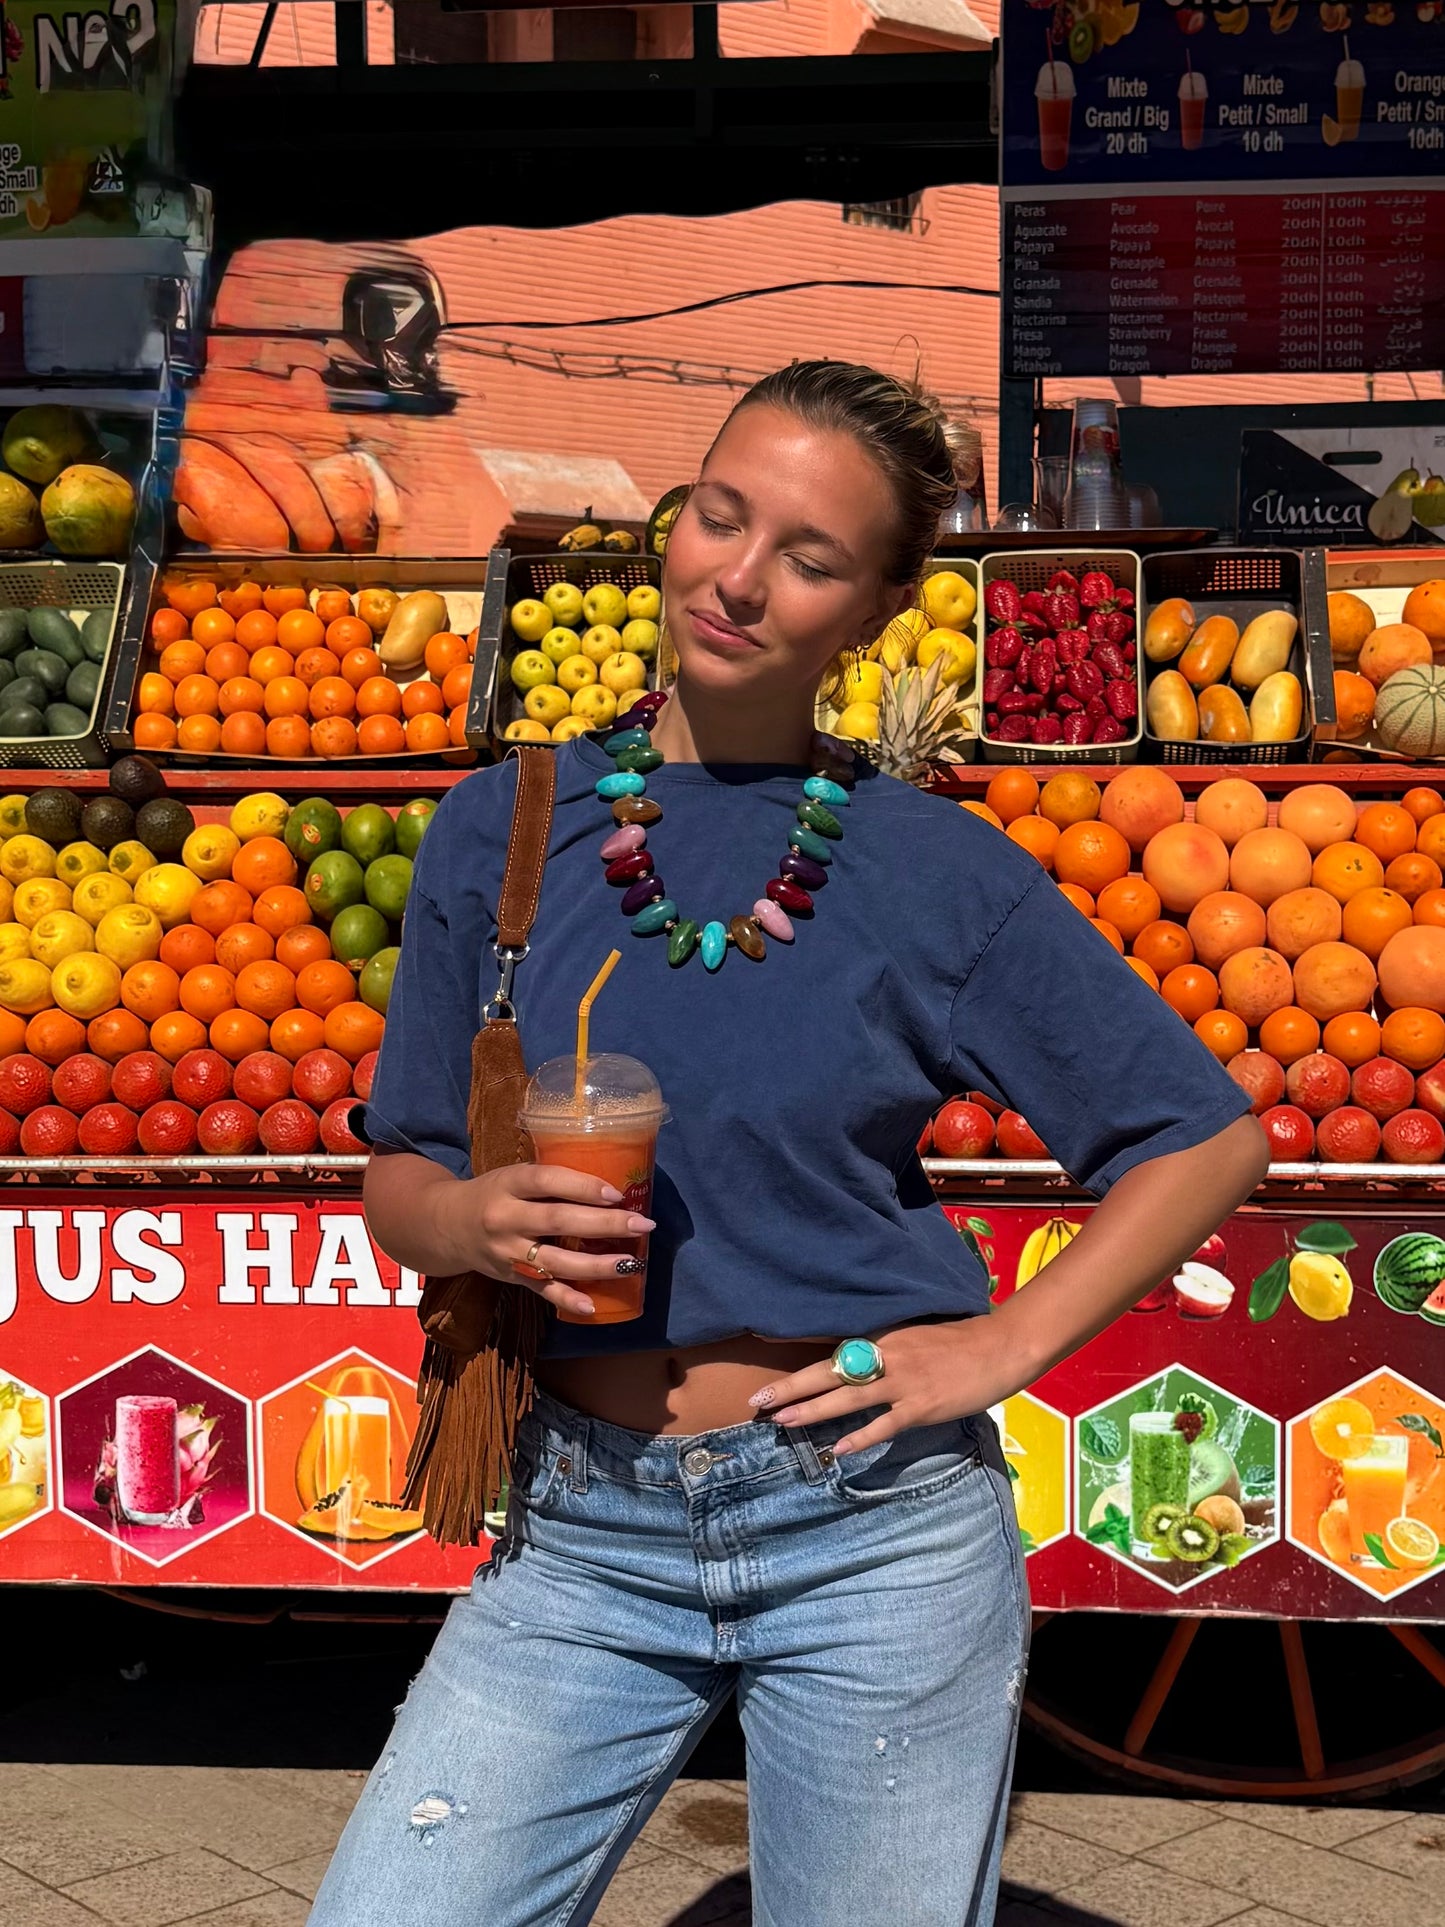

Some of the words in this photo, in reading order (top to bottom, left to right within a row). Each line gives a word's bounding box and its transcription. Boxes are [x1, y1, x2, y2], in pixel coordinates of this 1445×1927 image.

[1107, 77, 1148, 98] Mixte
[1243, 74, 1285, 95] Mixte
[1085, 107, 1132, 128] Grand
[1133, 106, 1141, 127] /
[1143, 106, 1171, 131] Big
[1218, 104, 1254, 126] Petit
[1256, 103, 1264, 125] /
[1265, 103, 1308, 125] Small
[1377, 101, 1413, 123] Petit
[1414, 99, 1422, 123] /
[1106, 133, 1125, 154] 20
[1128, 132, 1148, 154] dh
[1243, 131, 1261, 153] 10
[1264, 130, 1284, 152] dh
[1408, 127, 1445, 150] 10dh
[1014, 204, 1046, 217] Peras
[1111, 202, 1137, 216] Pear
[1282, 197, 1320, 210] 20dh
[1328, 196, 1367, 209] 10dh
[1015, 224, 1068, 240] Aguacate
[1111, 221, 1160, 235] Avocado
[1195, 219, 1234, 232] Avocat
[1281, 216, 1320, 230] 20dh
[1328, 215, 1366, 228] 10dh
[1014, 240, 1055, 255] Papaya
[1110, 239, 1152, 254] Papaya
[1281, 236, 1320, 248] 20dh
[1327, 235, 1366, 247] 10dh
[1110, 256, 1166, 272] Pineapple
[1194, 255, 1237, 268] Ananas
[1280, 254, 1319, 267] 20dh
[1327, 253, 1365, 266] 10dh
[1013, 277, 1061, 290] Granada
[1110, 277, 1159, 290] Grenade
[1193, 274, 1242, 288] Grenade
[1109, 293, 1179, 307] Watermelon
[1280, 291, 1318, 304] 20dh
[1325, 290, 1364, 303] 10dh
[1109, 312, 1165, 325] Nectarine
[1193, 310, 1248, 323] Nectarine
[1279, 308, 1318, 320] 20dh
[1325, 307, 1363, 319] 10dh
[1012, 328, 1044, 341] Fresa
[1109, 326, 1172, 342] Strawberry
[1193, 326, 1228, 339] Fraise
[1279, 324, 1318, 336] 20dh
[1325, 322, 1363, 335] 10dh
[1013, 345, 1051, 360] Mango
[1109, 343, 1148, 359] Mango
[1192, 341, 1238, 356] Mangue
[1279, 340, 1318, 353] 20dh
[1325, 338, 1363, 351] 10dh
[1012, 359, 1062, 374] Pitahaya
[1109, 358, 1150, 374] Dragon
[1191, 356, 1233, 371] Dragon
[216, 1212, 425, 1306] HA
